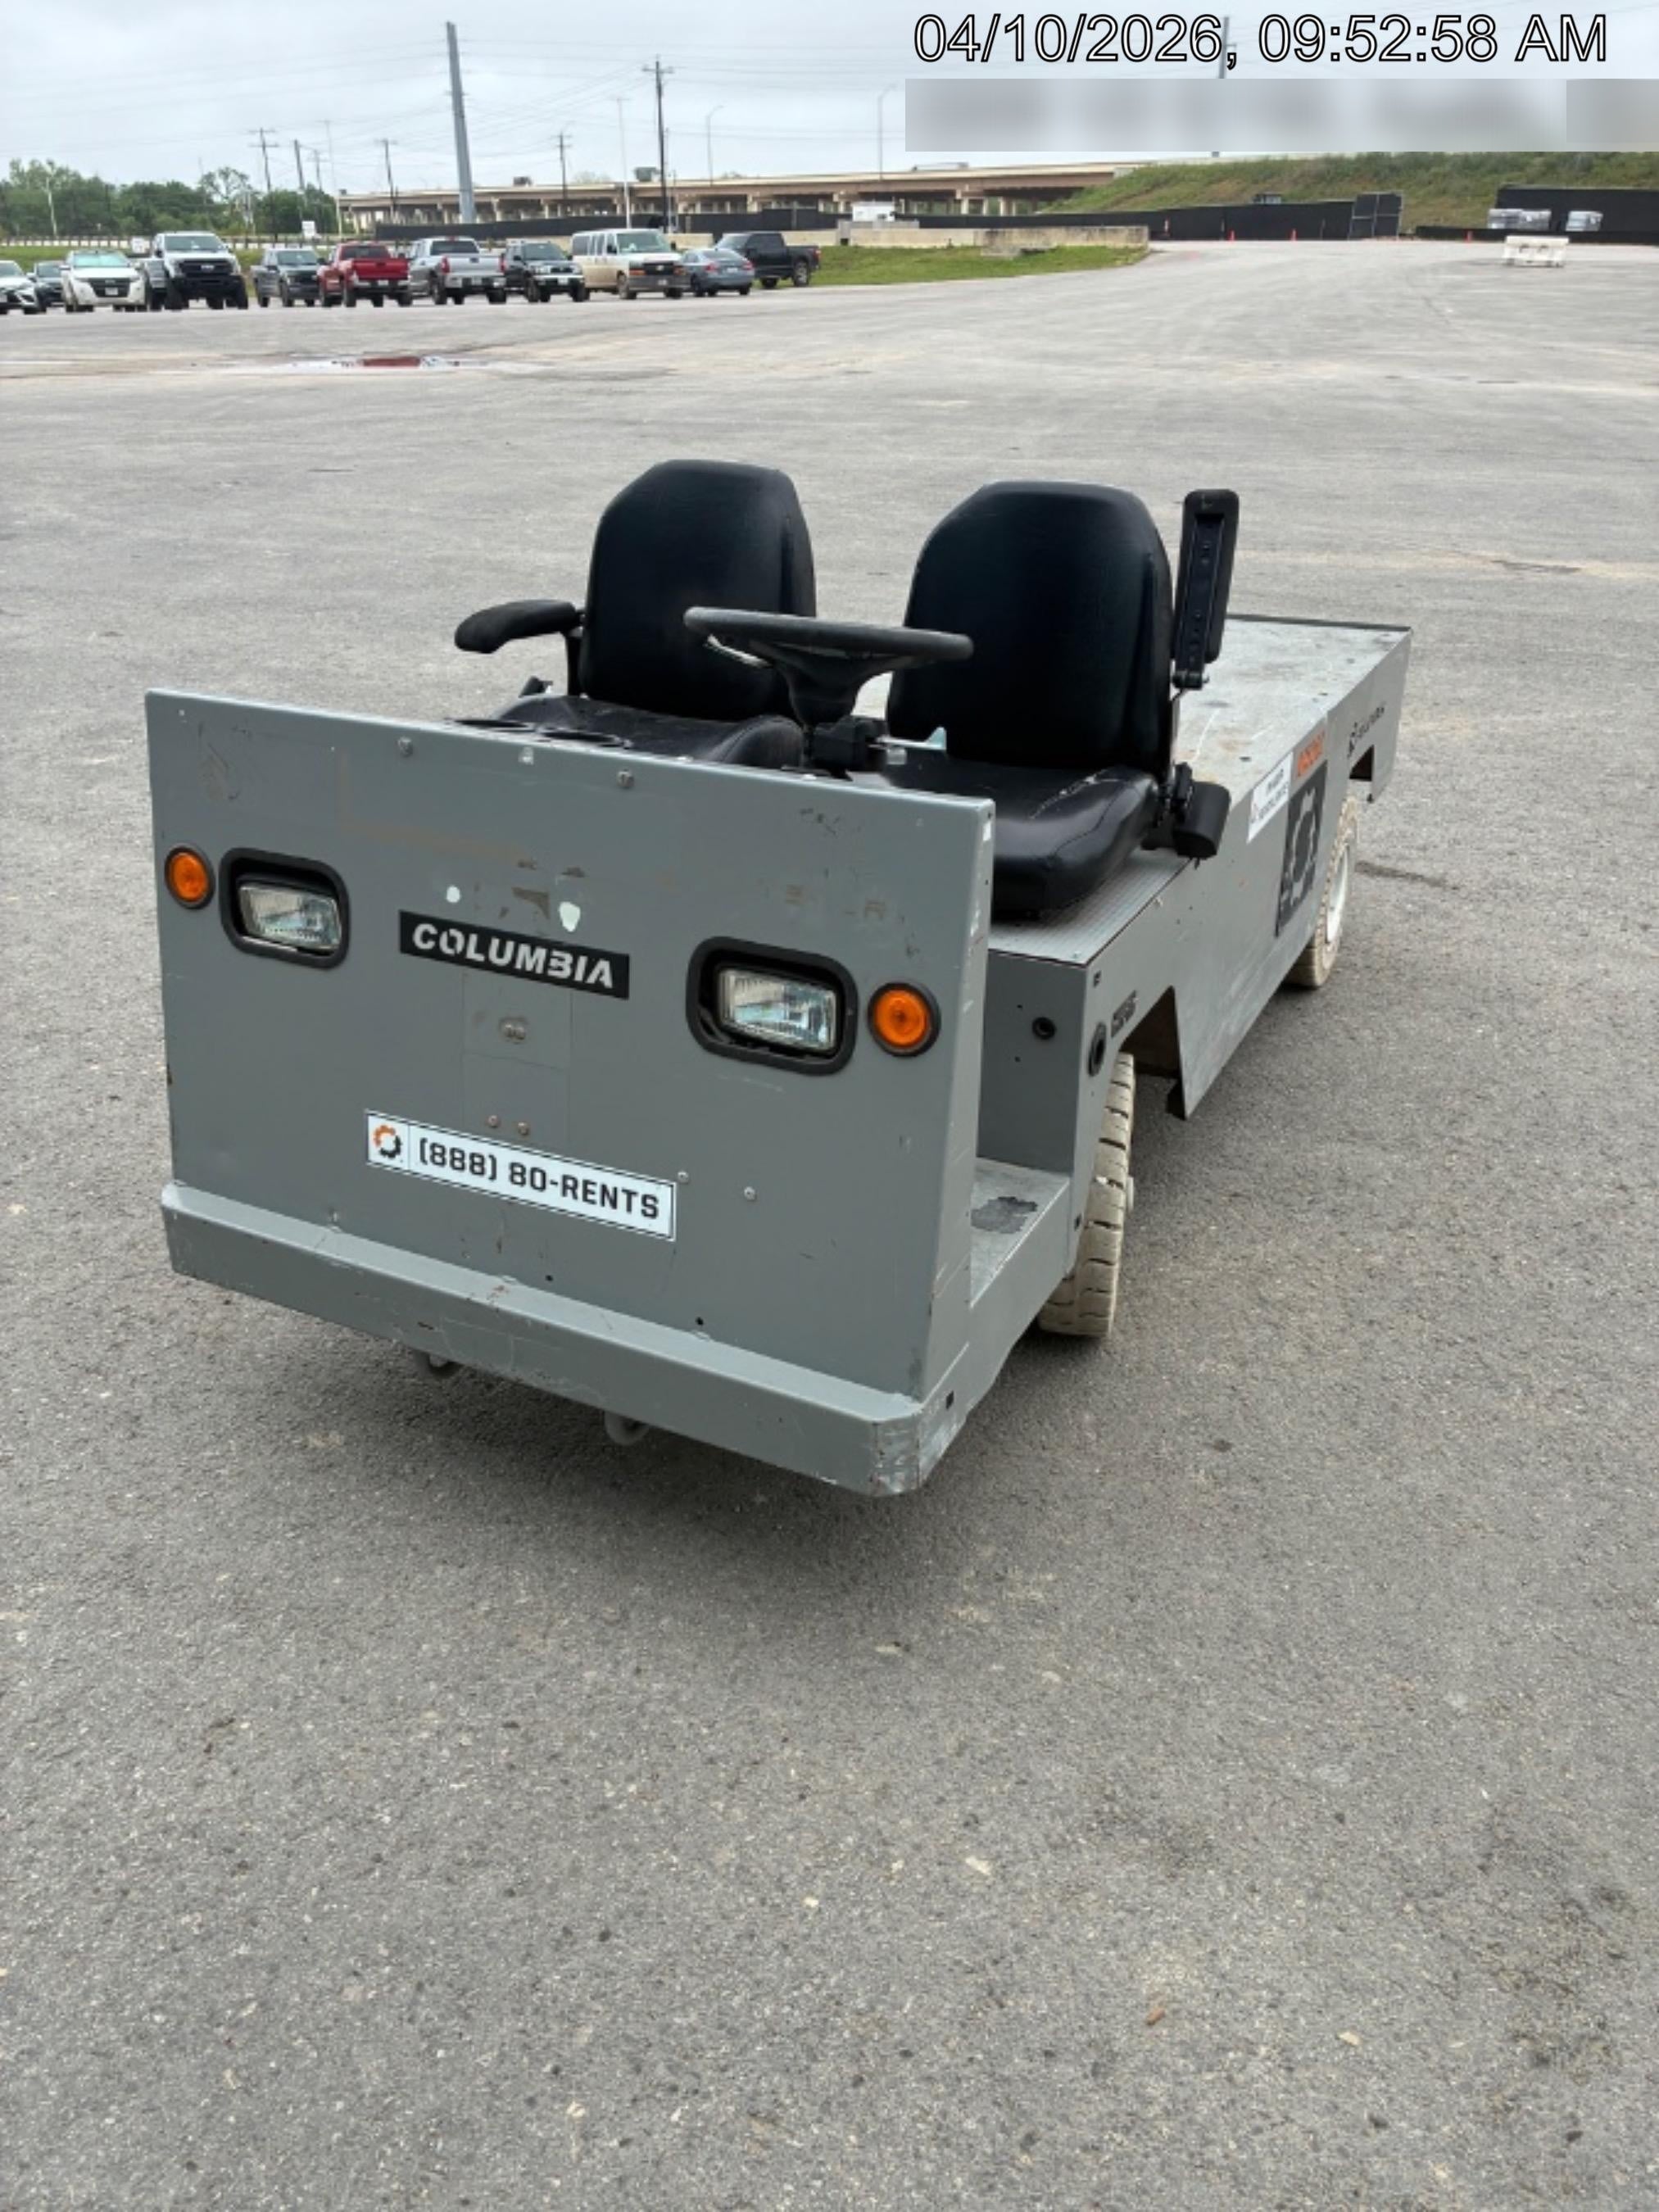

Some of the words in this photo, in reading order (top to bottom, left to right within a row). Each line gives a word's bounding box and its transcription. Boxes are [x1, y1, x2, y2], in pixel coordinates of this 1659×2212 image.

[411, 922, 614, 989] COLUMBIA
[419, 1136, 497, 1182] (888)
[509, 1162, 660, 1220] 80-RENTS
